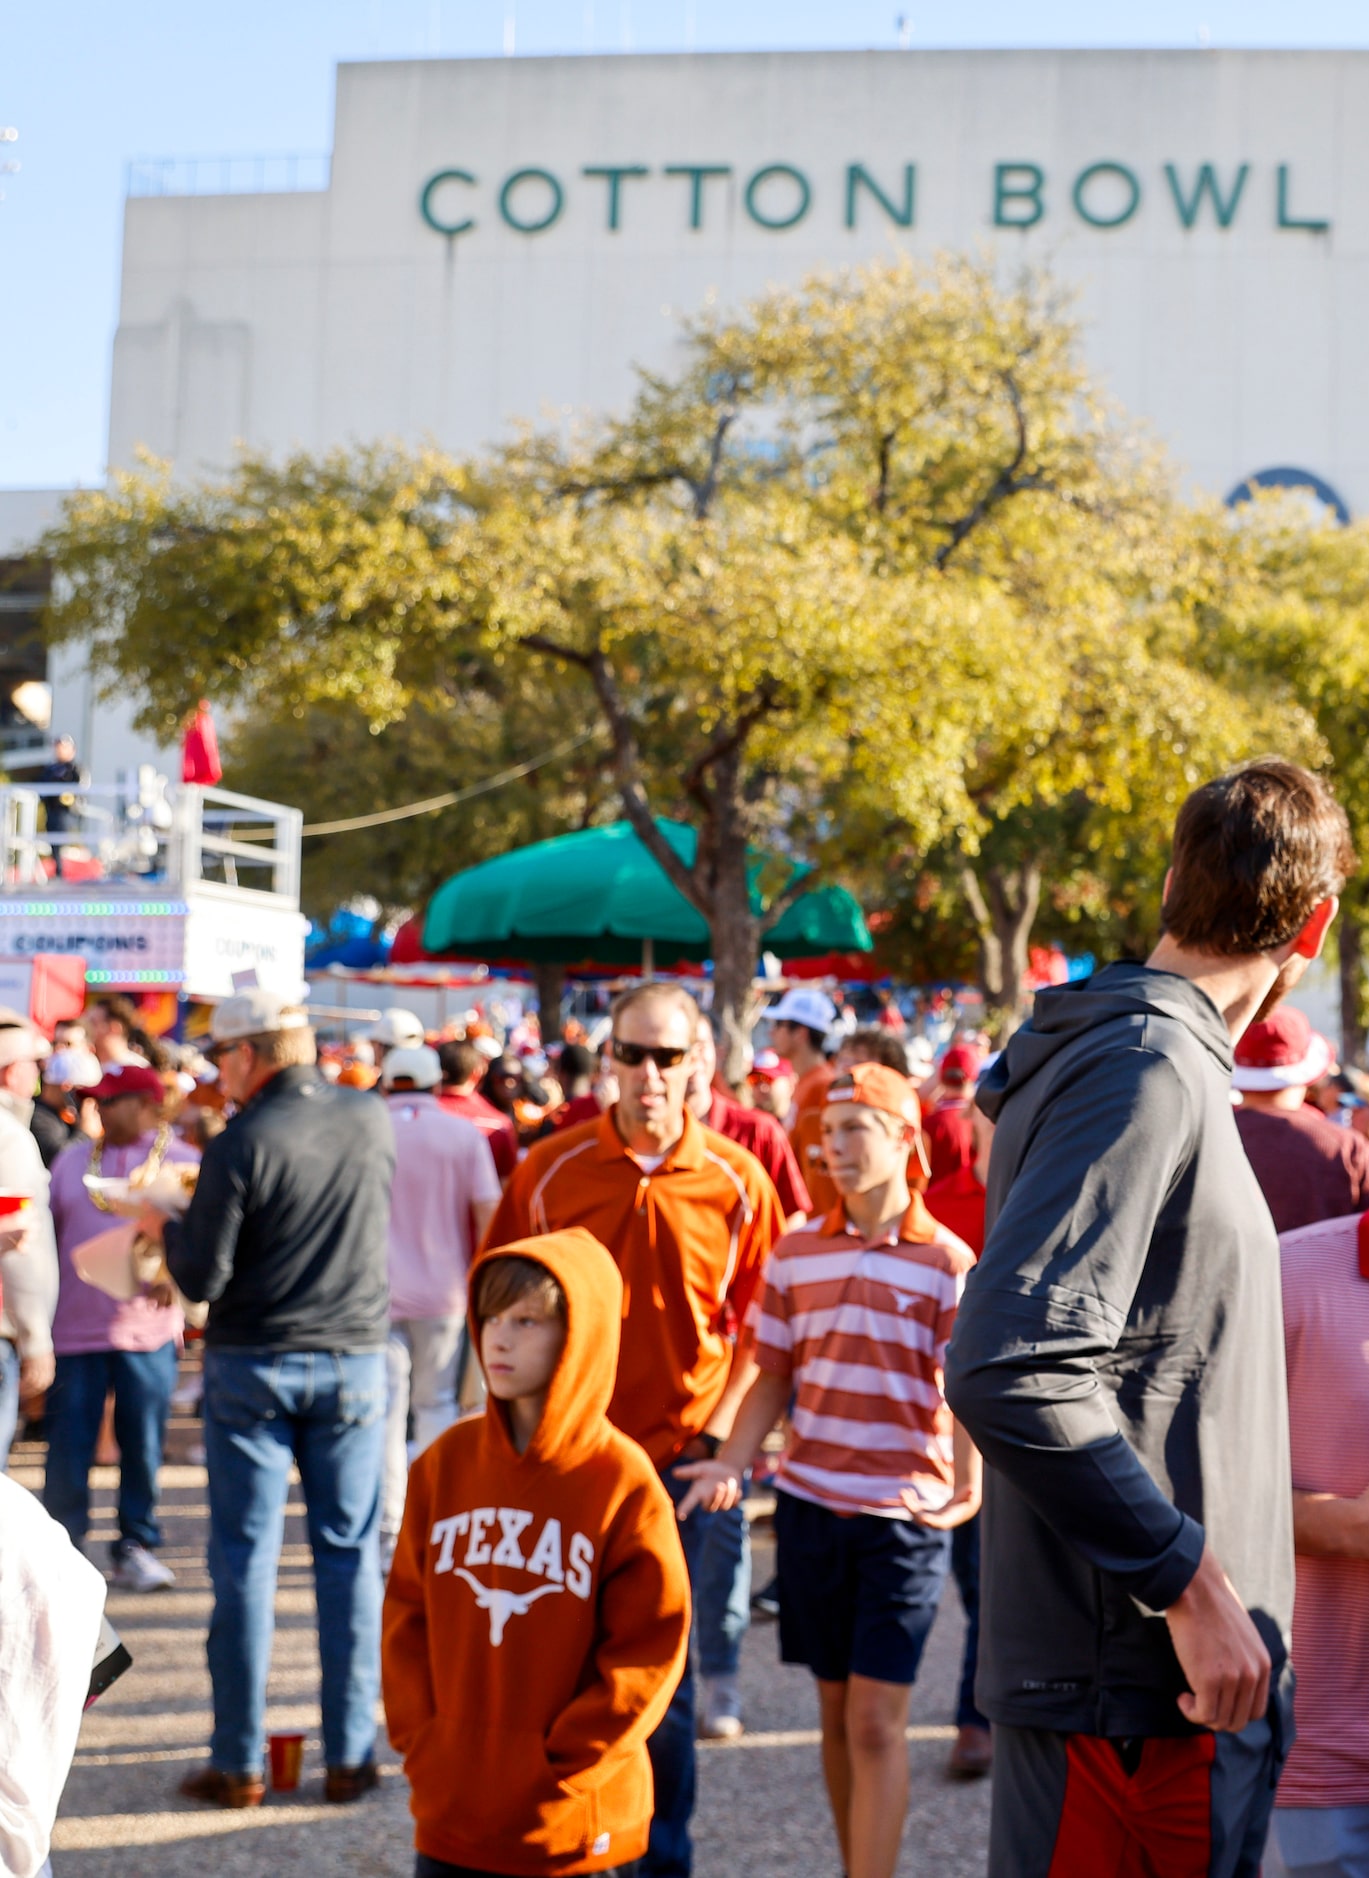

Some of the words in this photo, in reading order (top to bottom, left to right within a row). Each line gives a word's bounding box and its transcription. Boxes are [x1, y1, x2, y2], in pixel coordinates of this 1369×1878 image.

[420, 161, 918, 235] COTTON
[993, 160, 1331, 233] BOWL
[431, 1507, 594, 1600] TEXAS
